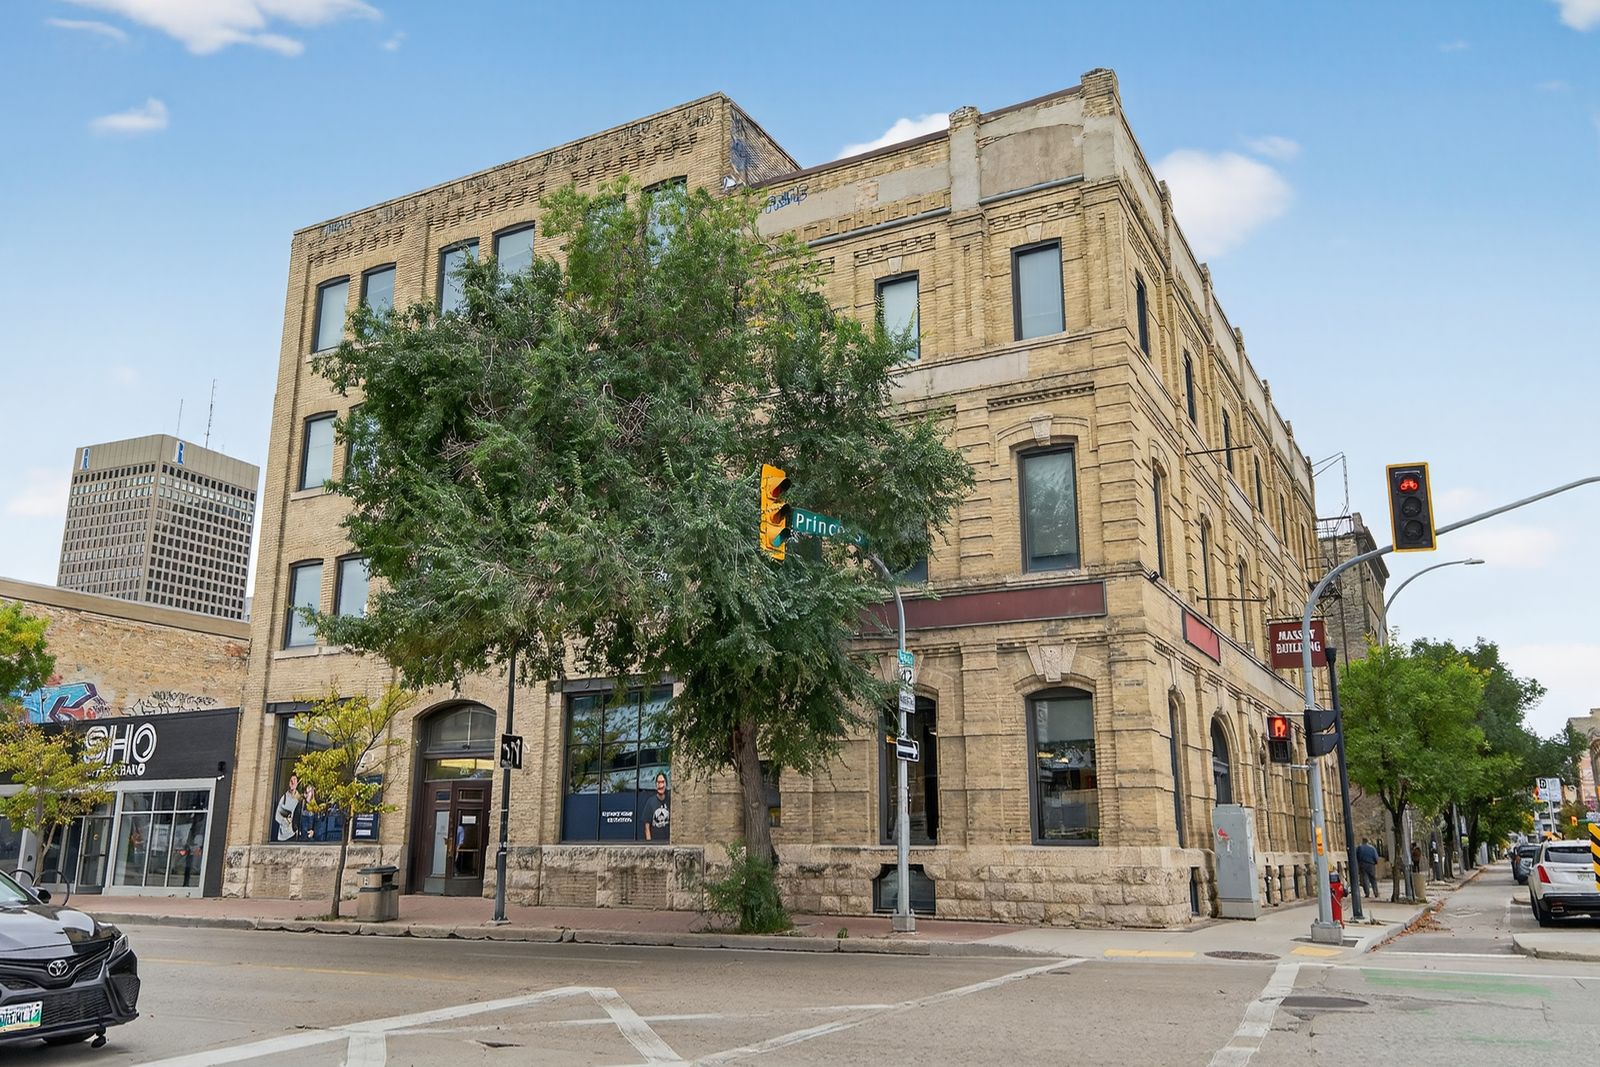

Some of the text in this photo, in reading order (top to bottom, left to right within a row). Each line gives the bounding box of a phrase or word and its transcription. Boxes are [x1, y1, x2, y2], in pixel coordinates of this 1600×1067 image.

[796, 513, 862, 543] Princs
[1278, 629, 1316, 641] MASSY
[1276, 641, 1321, 654] BUILDNG
